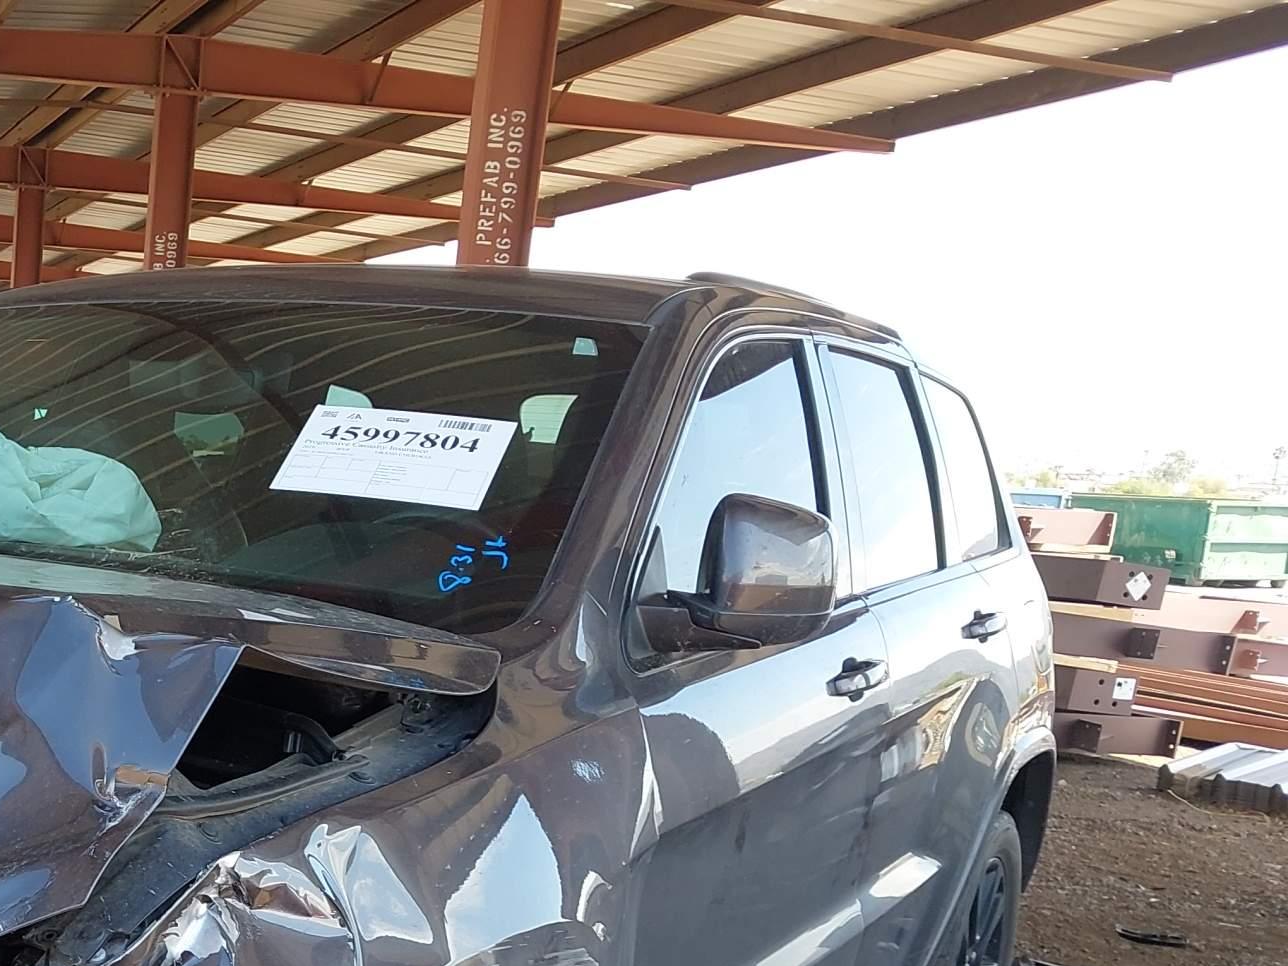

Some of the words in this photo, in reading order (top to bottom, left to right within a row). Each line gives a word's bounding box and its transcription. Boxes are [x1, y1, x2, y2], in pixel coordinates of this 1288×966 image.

[487, 107, 509, 148] INC.
[475, 160, 501, 246] PREFAB
[153, 231, 167, 256] INC.
[320, 425, 481, 453] 45997804
